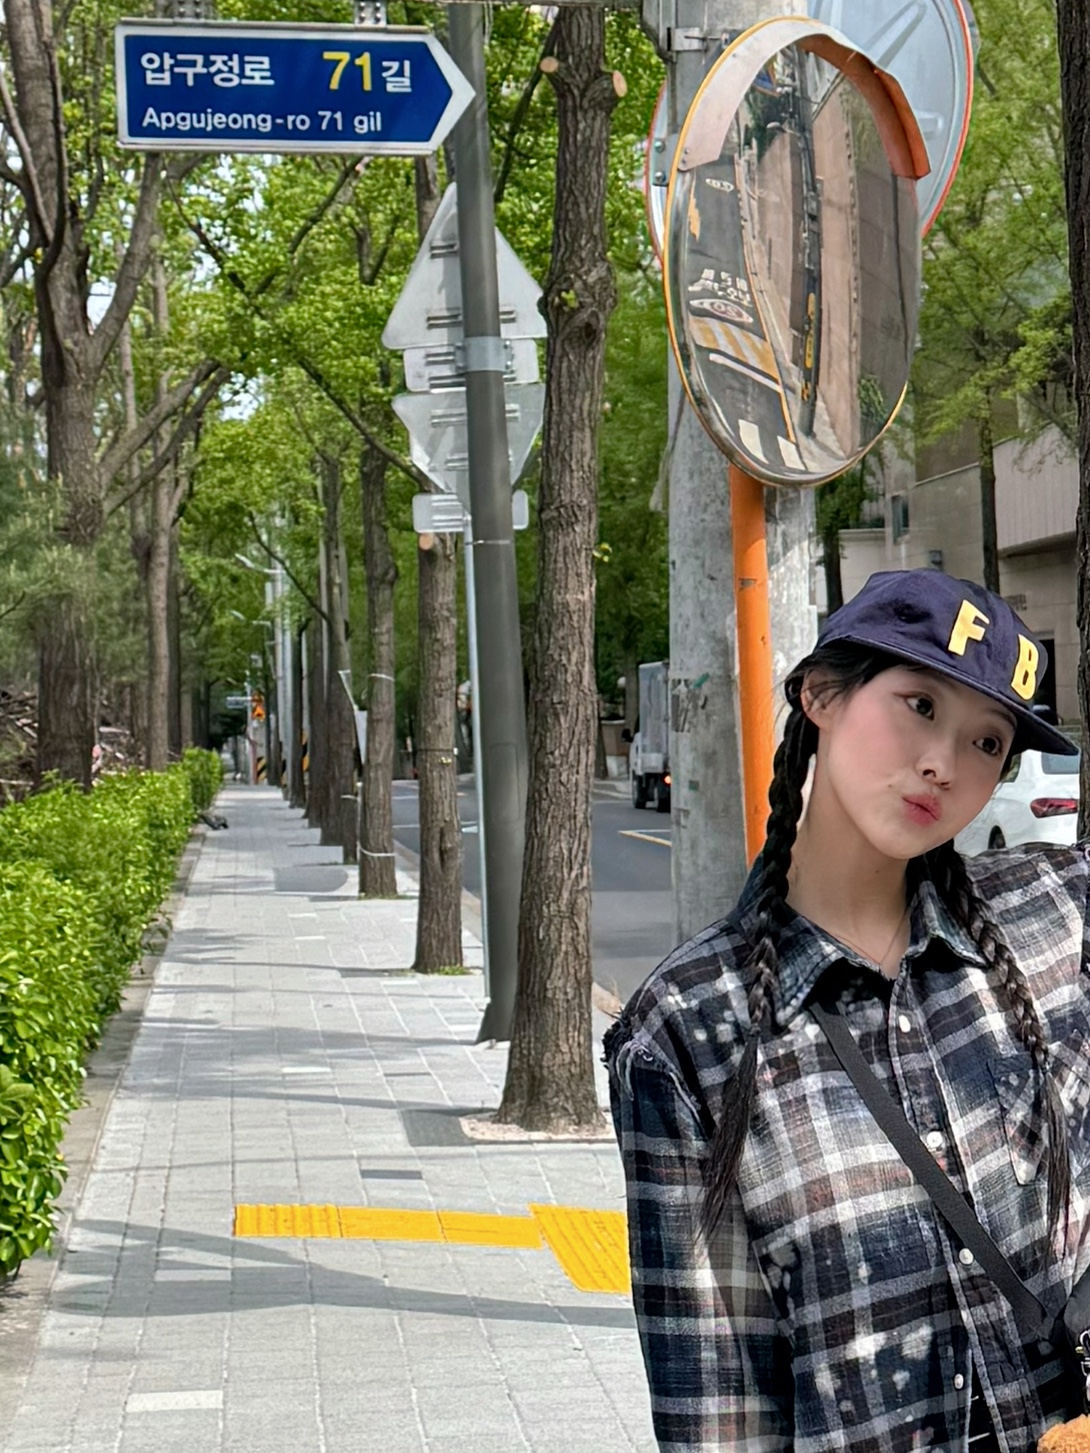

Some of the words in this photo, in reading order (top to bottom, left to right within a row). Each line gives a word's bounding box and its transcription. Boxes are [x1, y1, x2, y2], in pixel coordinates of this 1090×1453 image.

[140, 51, 275, 87] 압구정로
[141, 106, 311, 133] Apgujeong-ro
[317, 111, 344, 132] 71
[353, 111, 382, 134] gil
